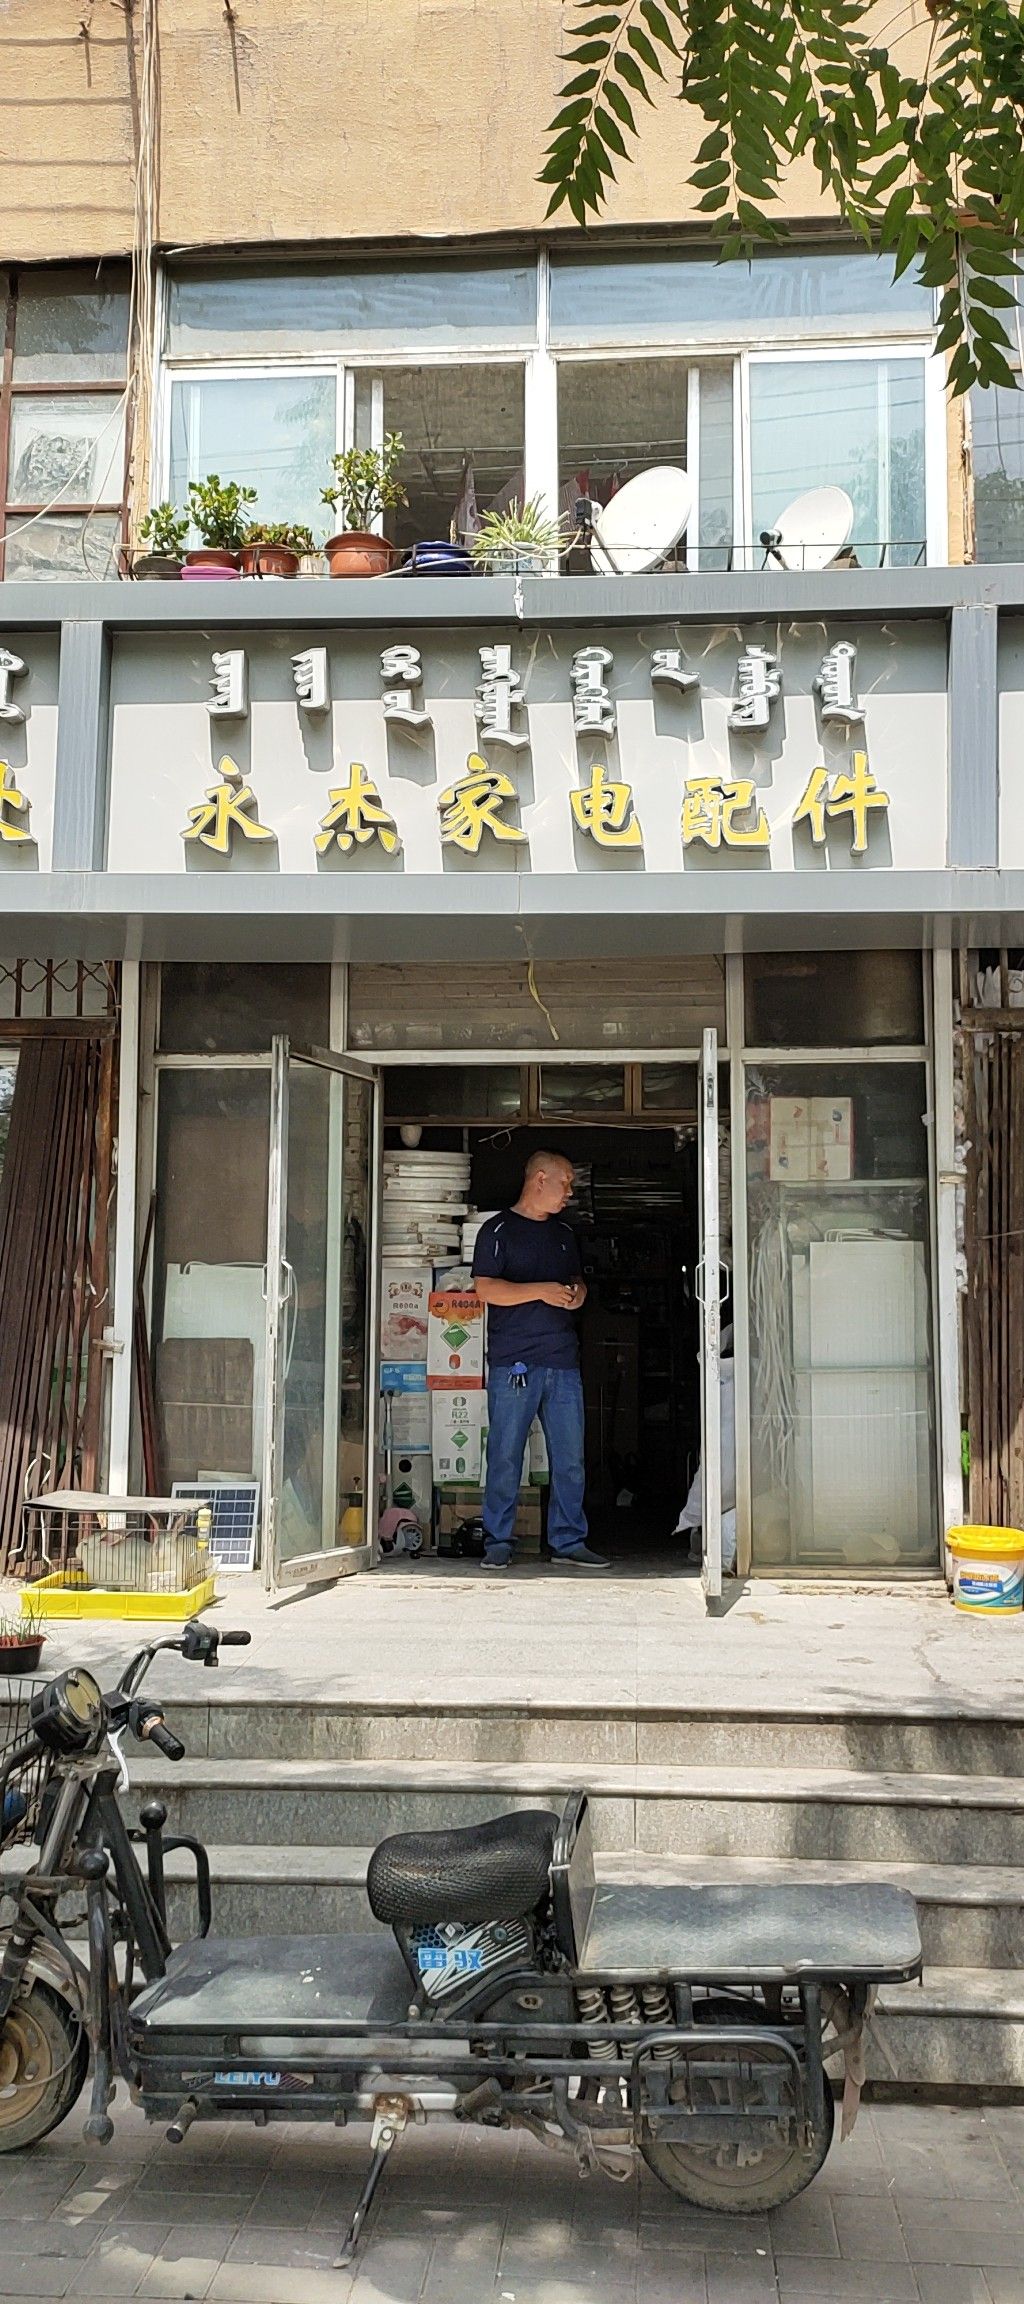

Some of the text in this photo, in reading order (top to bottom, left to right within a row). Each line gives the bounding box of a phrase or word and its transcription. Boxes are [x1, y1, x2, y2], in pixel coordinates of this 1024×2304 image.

[180, 751, 890, 857] 永杰家电配件
[451, 1410, 469, 1419] R22
